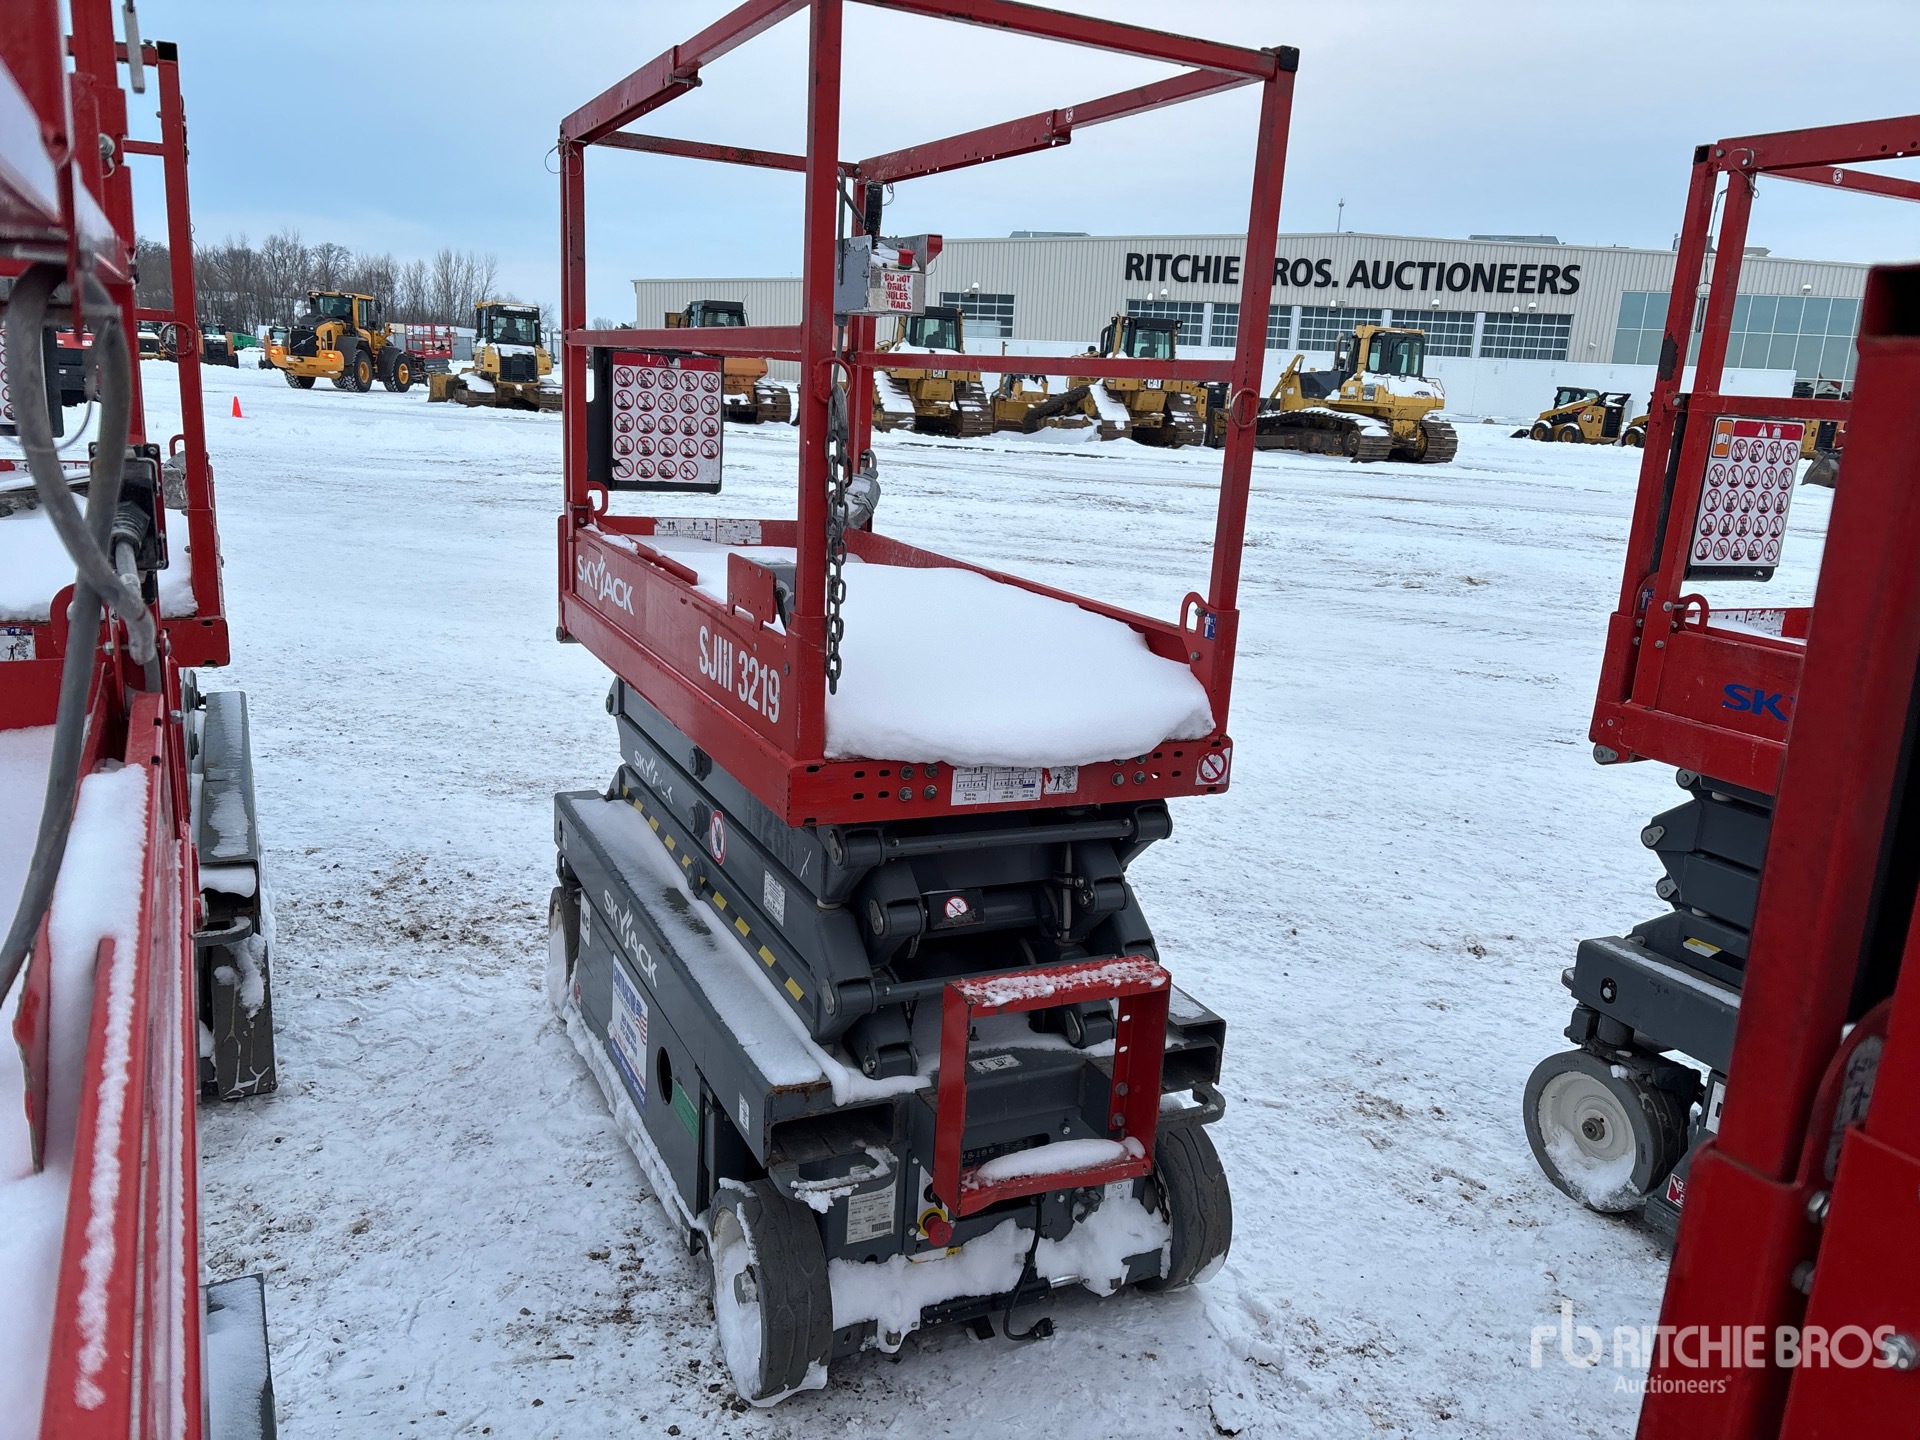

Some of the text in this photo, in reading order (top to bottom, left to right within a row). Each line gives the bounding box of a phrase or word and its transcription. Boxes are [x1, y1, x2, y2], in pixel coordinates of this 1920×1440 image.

[1125, 252, 1581, 295] RITCHIE ROS. AUCTIONEERS
[576, 554, 635, 616] SKYJACK
[699, 625, 780, 724] SJIII 3219
[1721, 683, 1797, 722] SK
[603, 889, 658, 989] SKYJACK
